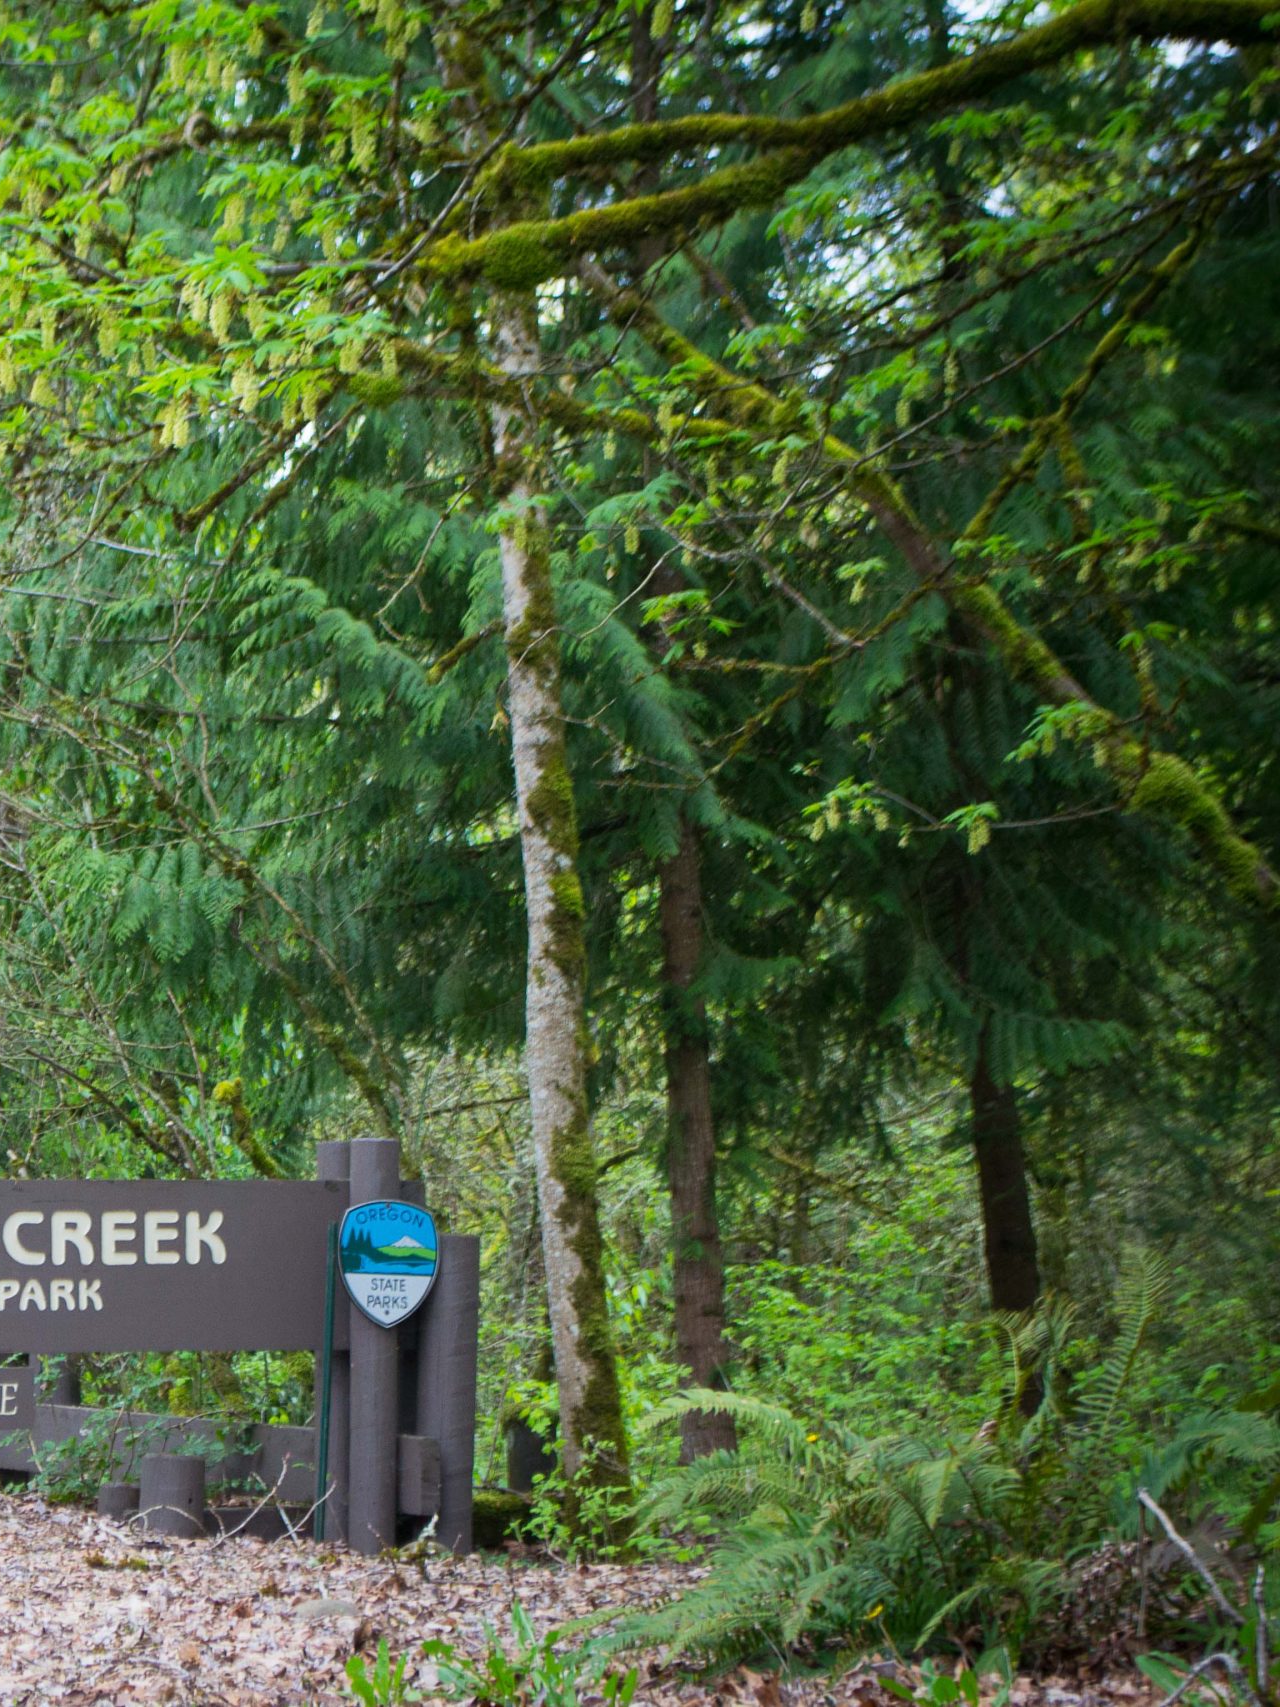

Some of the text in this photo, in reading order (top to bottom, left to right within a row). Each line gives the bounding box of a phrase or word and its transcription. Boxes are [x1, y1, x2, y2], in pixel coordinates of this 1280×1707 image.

[355, 1207, 425, 1227] OREGON
[2, 1209, 228, 1267] CREEK
[371, 1278, 406, 1292] STATE
[366, 1295, 408, 1310] PARKS
